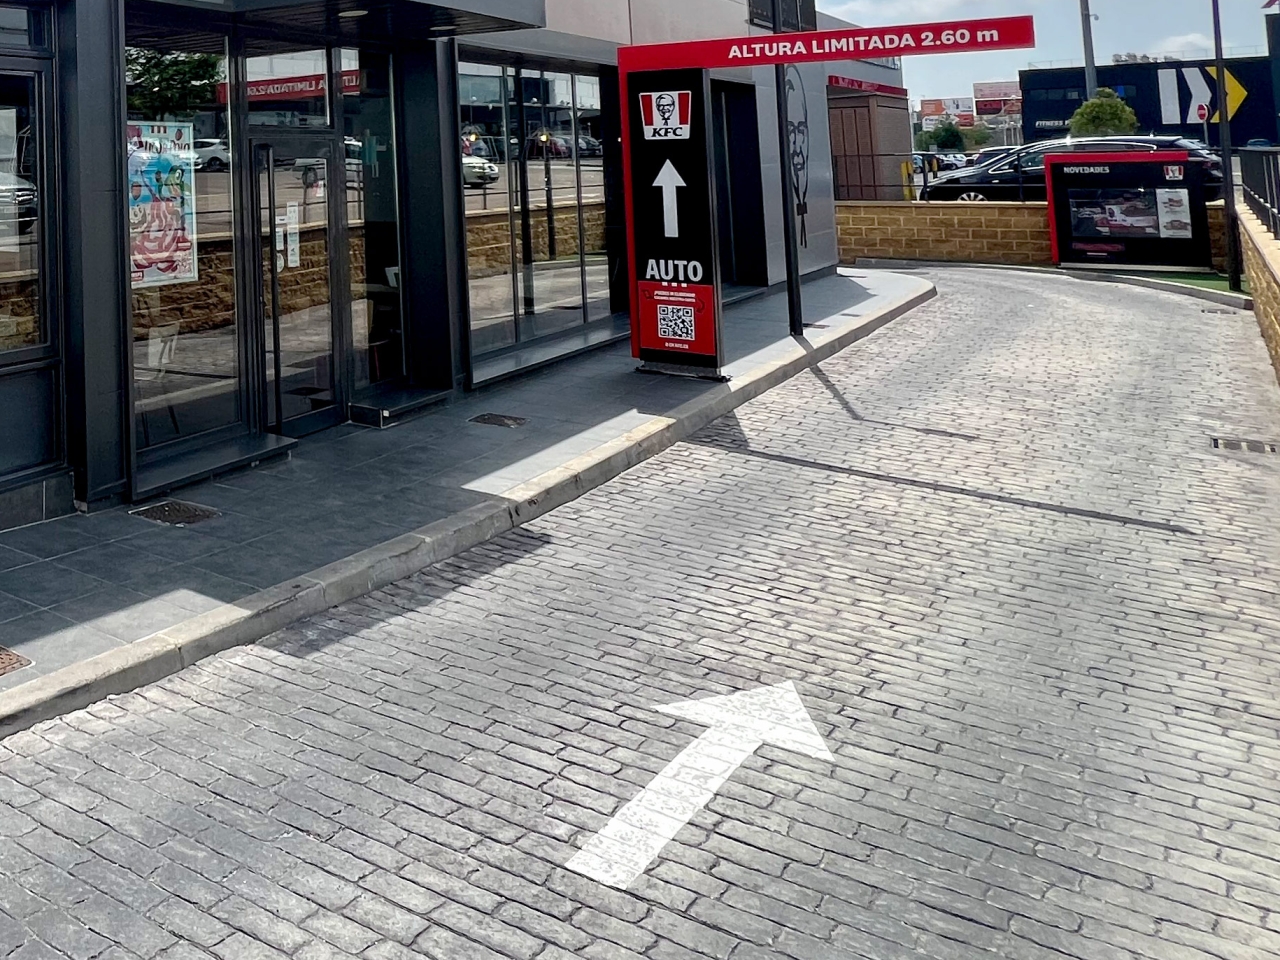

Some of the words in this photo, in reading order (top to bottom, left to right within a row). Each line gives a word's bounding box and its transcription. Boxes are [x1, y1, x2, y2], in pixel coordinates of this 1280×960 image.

[728, 41, 807, 59] ALTURA
[812, 33, 916, 54] LIMITADA
[920, 28, 971, 46] 2.60
[976, 27, 999, 43] m
[651, 126, 683, 138] KFC
[1063, 166, 1110, 174] NOVEDADES
[645, 258, 703, 282] AUTO
